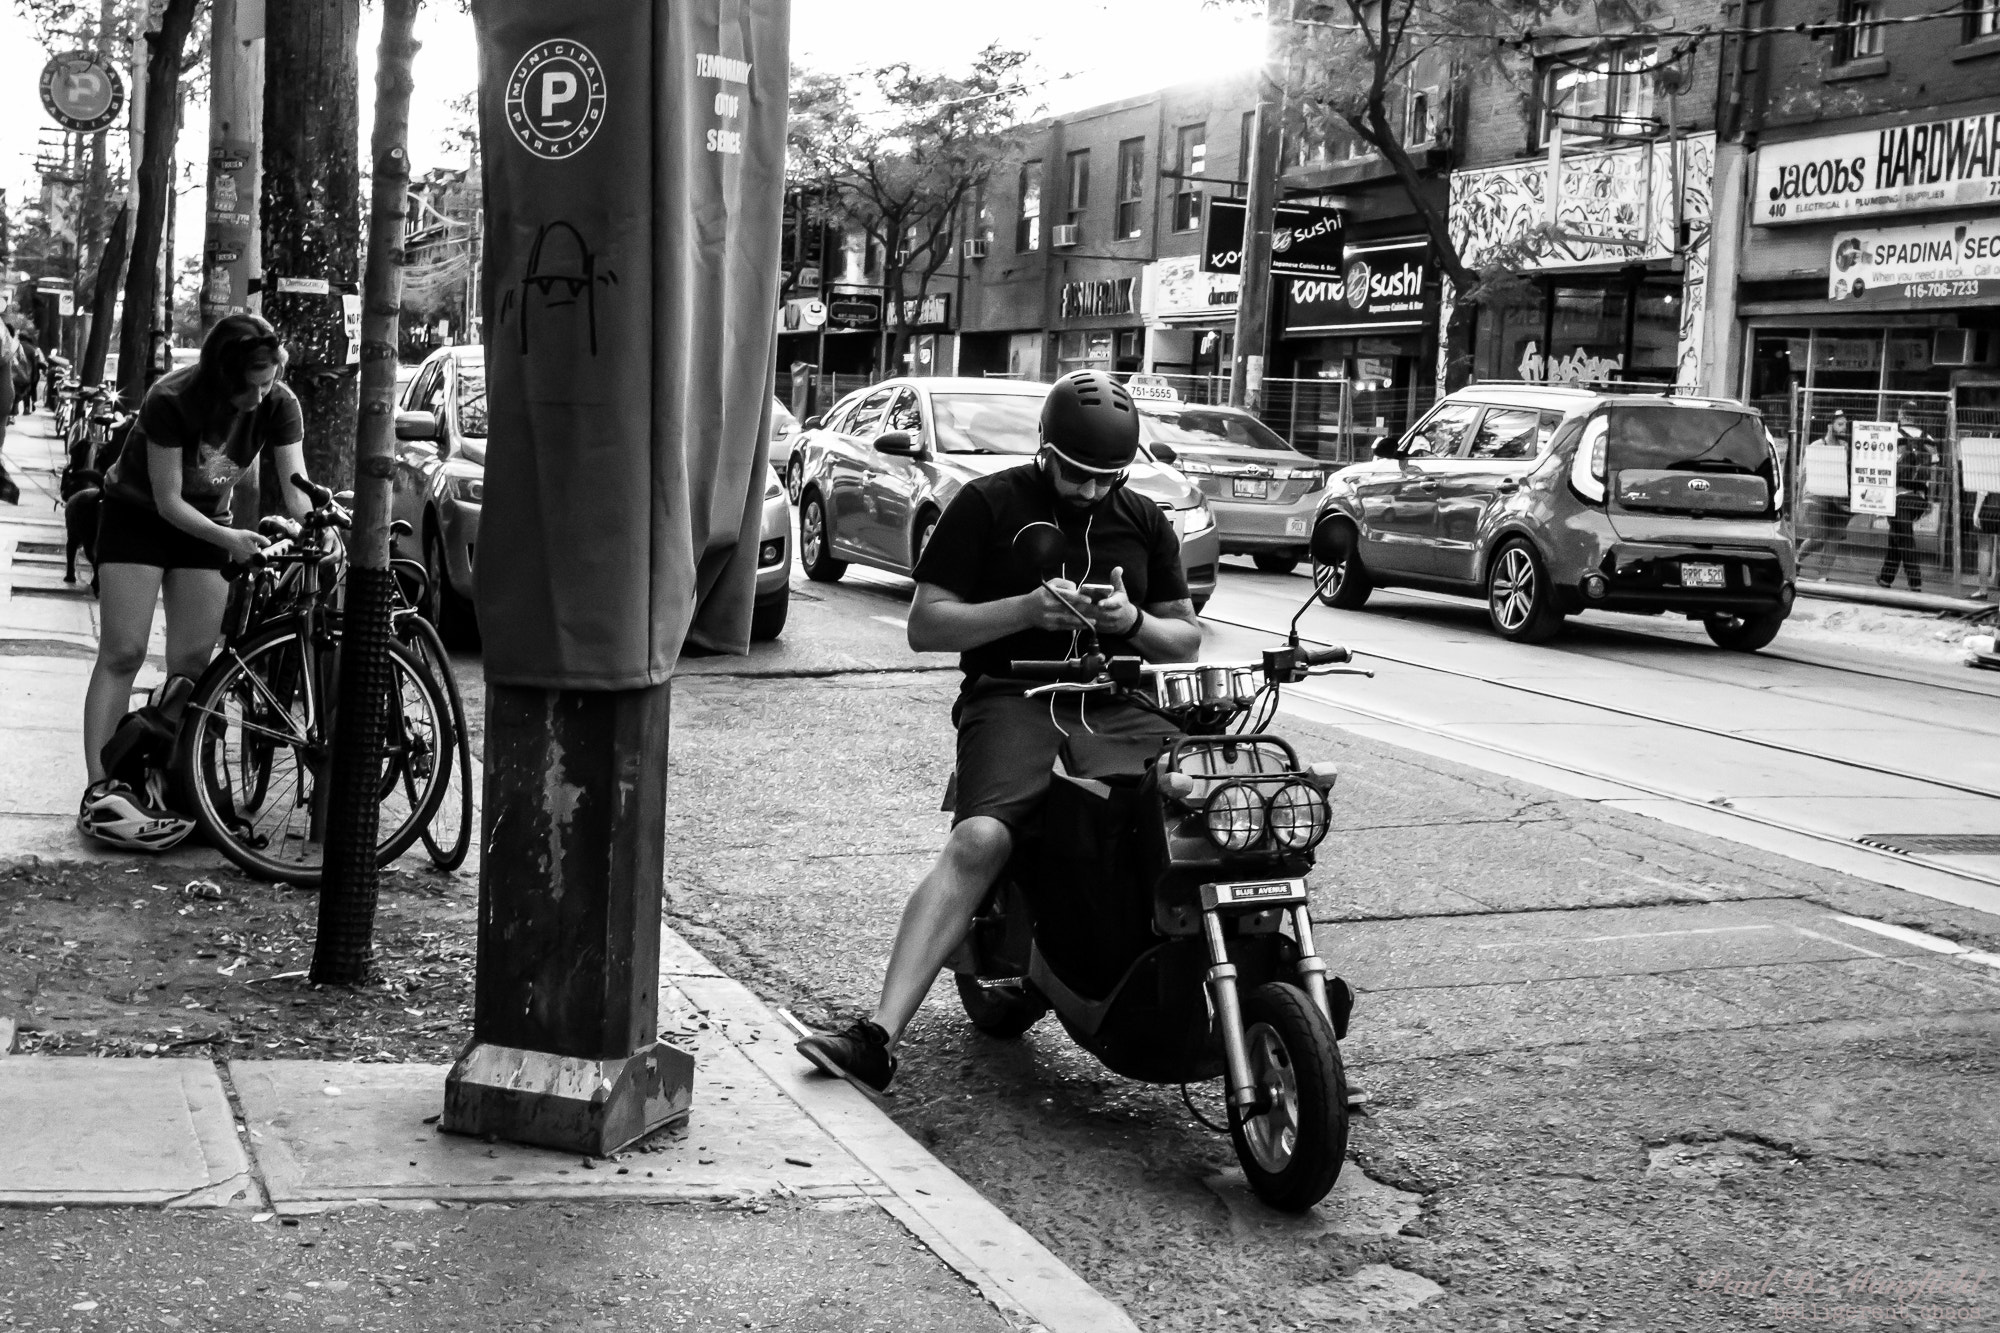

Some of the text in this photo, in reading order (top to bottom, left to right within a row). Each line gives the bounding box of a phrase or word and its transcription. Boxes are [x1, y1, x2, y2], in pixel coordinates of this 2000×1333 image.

[513, 45, 599, 96] MUNICIPAL
[541, 72, 577, 117] P
[513, 109, 599, 153] PARKING
[1768, 203, 1786, 218] 410
[1796, 201, 1840, 213] ELECTRICAL
[1855, 194, 1898, 207] PLUMBING
[1905, 190, 1945, 202] SUPPLIES
[1294, 214, 1343, 243] sushi
[1272, 260, 1298, 269] Japanese
[1299, 262, 1319, 270] Cuisine
[1875, 240, 1952, 265] SPADINA
[1371, 262, 1423, 298] sushi
[1872, 271, 1895, 282] When
[1897, 272, 1912, 282] you
[1914, 269, 1936, 280] need
[1904, 280, 1979, 298] 416-706-7233
[1131, 386, 1172, 399] 751-5555
[1235, 885, 1288, 896] BLUE AVENUE
